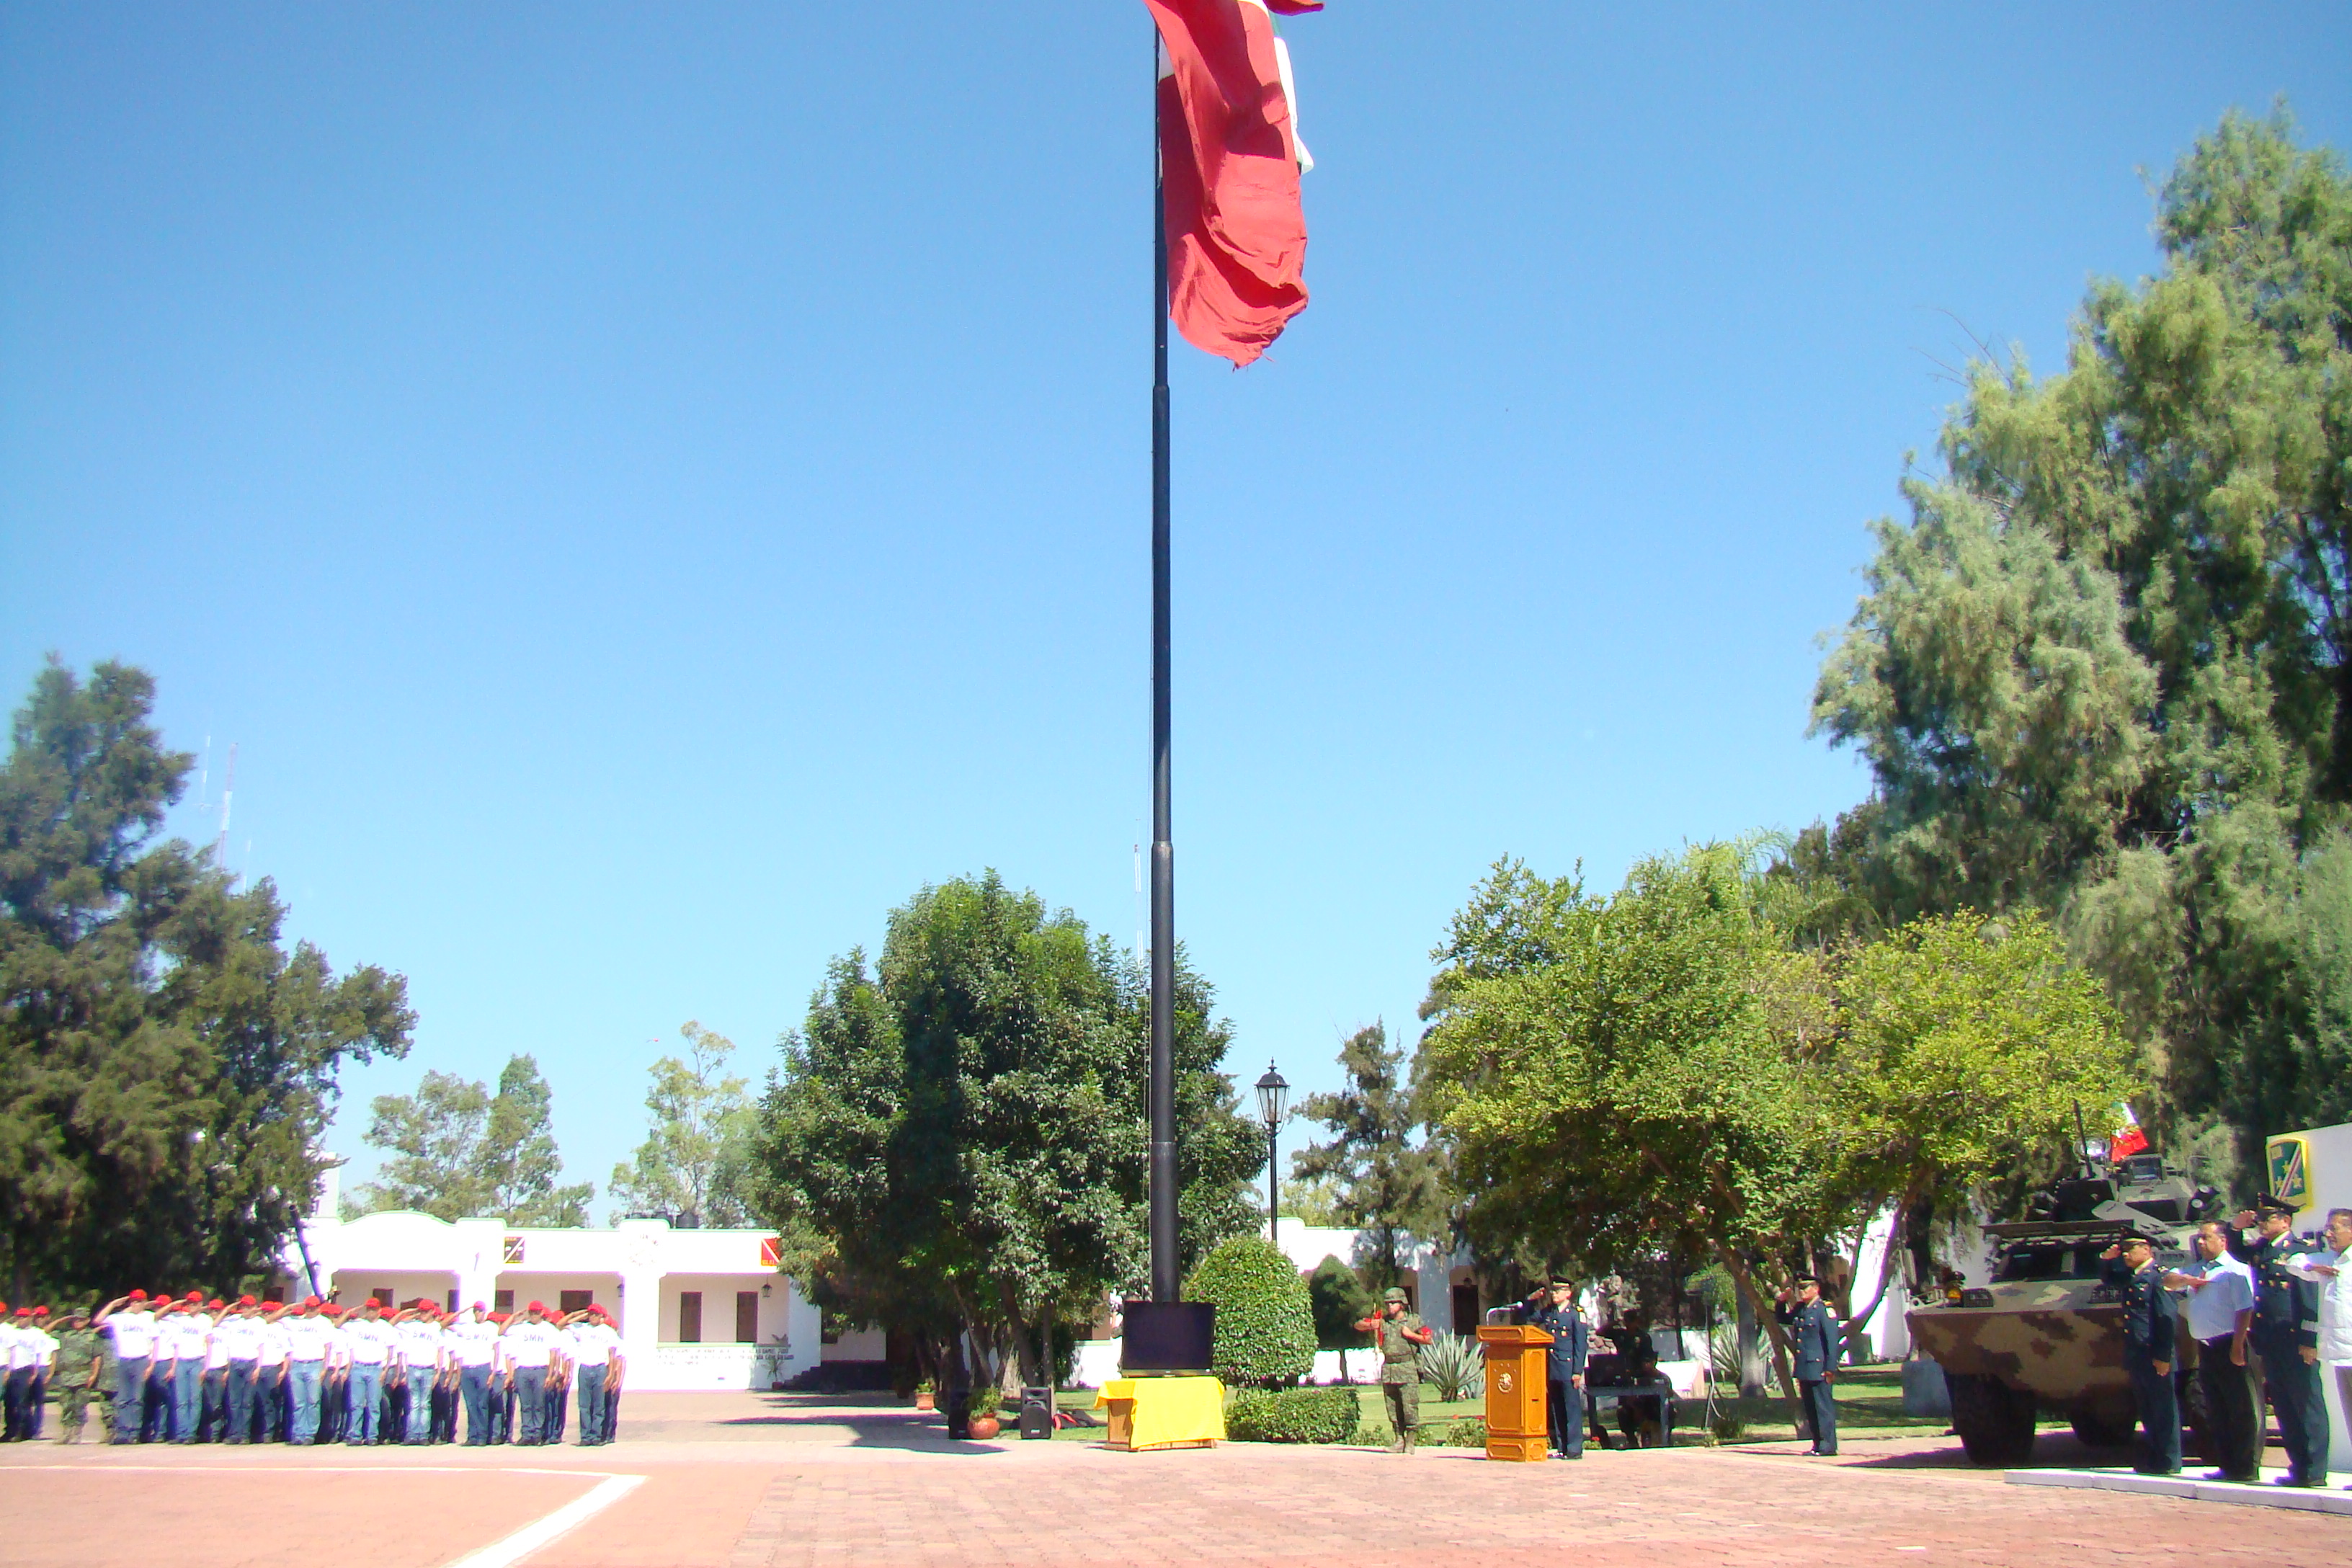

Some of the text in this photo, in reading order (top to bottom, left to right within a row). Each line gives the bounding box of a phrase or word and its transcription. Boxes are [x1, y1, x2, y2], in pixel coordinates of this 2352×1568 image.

[357, 1331, 378, 1342] SMN
[413, 1330, 432, 1341] SMN
[523, 1334, 544, 1342] SMN
